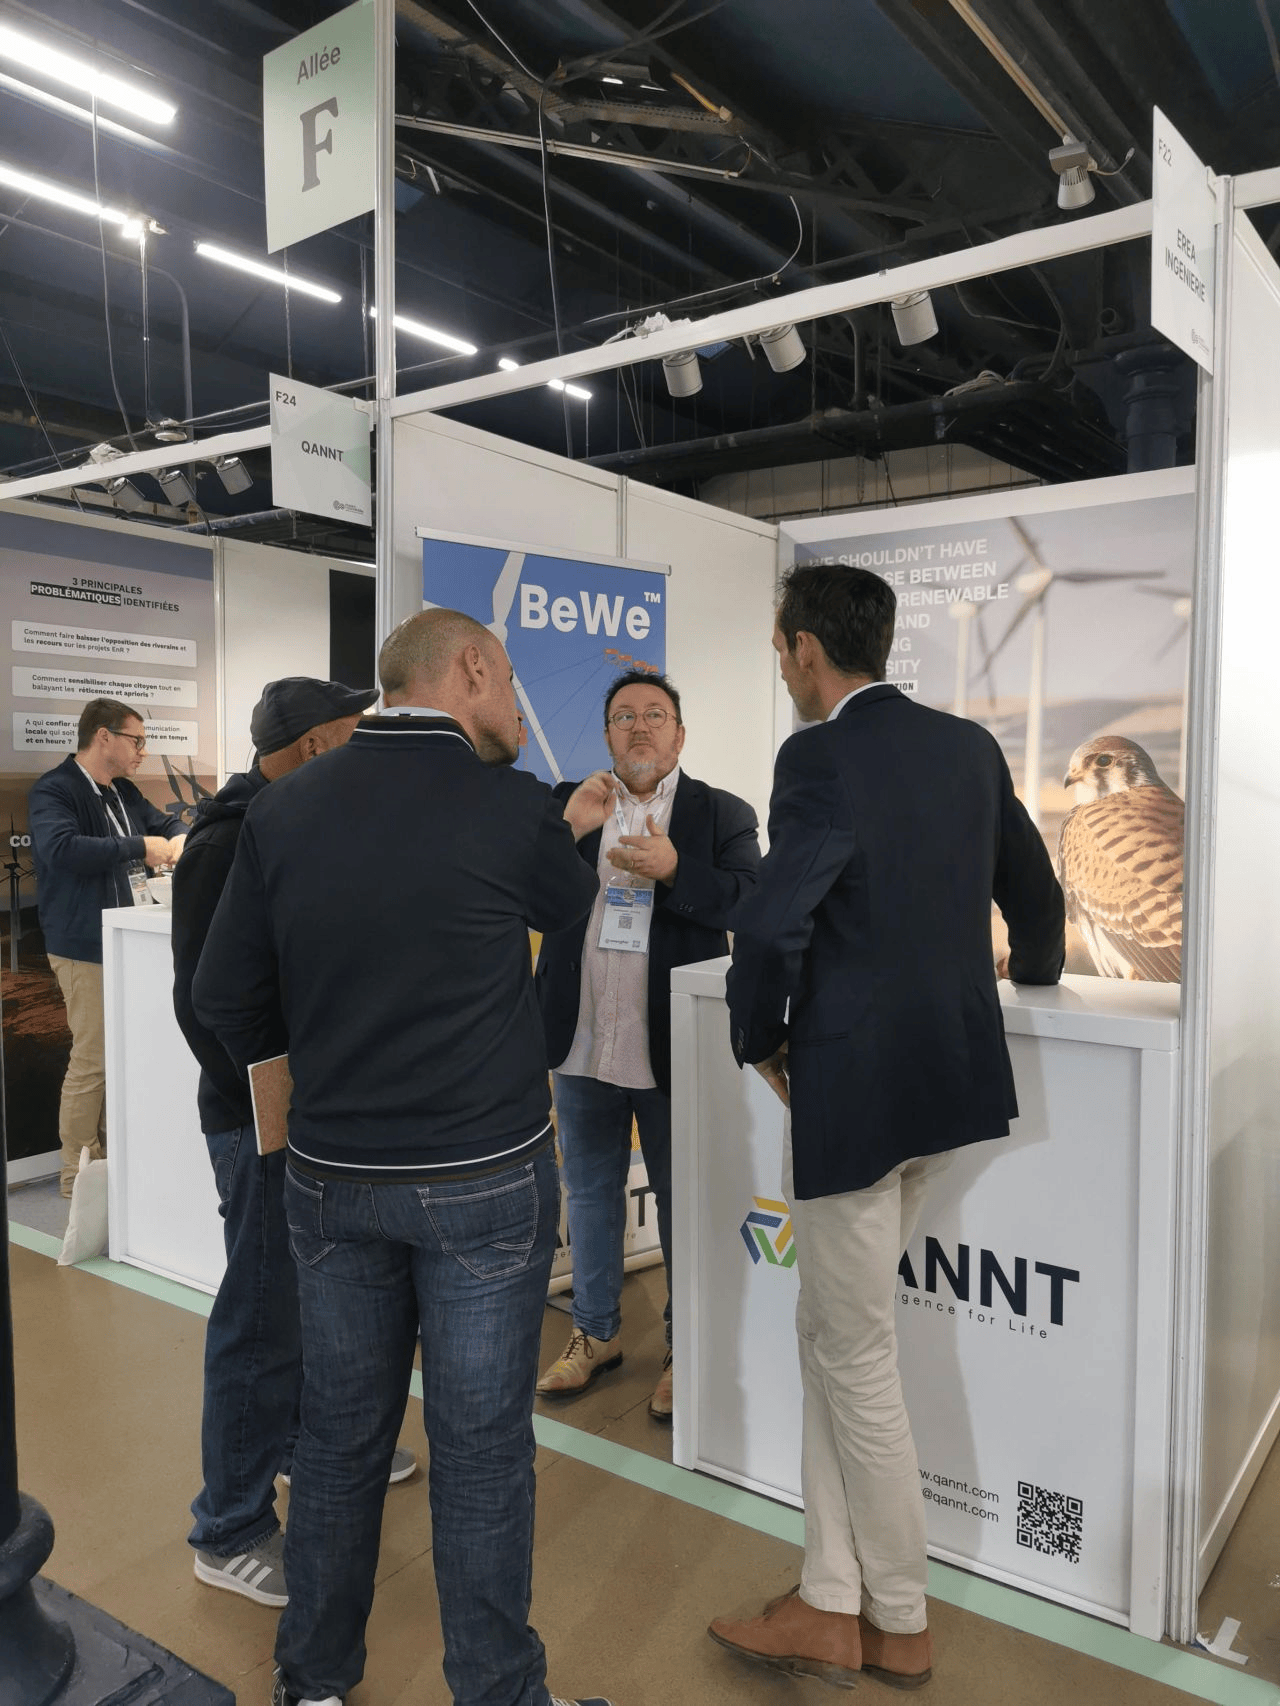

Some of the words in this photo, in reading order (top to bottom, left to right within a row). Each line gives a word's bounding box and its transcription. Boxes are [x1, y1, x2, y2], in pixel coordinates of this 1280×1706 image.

[297, 45, 341, 85] Allée
[299, 96, 339, 193] F
[1158, 138, 1173, 167] F22
[1177, 227, 1196, 265] EREA
[1165, 246, 1206, 303] INGENIERIE
[275, 390, 297, 407] F24
[301, 440, 344, 463] QANNT
[838, 544, 935, 568] SHOULDN'T
[940, 538, 988, 559] HAVE
[881, 570, 905, 587] SE
[909, 561, 997, 585] BETWEEN
[72, 577, 78, 586] 3
[81, 578, 143, 595] PRINCIPALES
[31, 584, 121, 604] PROBLÉMATIQUES
[123, 597, 180, 612] IDENTIFIÉES
[24, 628, 58, 638] Comment
[59, 631, 75, 639] faire
[76, 633, 100, 642] baisser
[101, 636, 139, 647] l'opposition
[152, 642, 179, 651] riverains
[36, 639, 63, 647] recours
[87, 643, 111, 653] projets
[891, 637, 912, 653] NG
[885, 658, 921, 676] SITY
[32, 674, 67, 683] Comment
[68, 678, 108, 686] sensibiliser
[108, 680, 133, 689] chaque
[133, 682, 158, 691] citoyen
[32, 683, 63, 692] balayant
[64, 685, 75, 693] les
[78, 687, 114, 695] réticences
[123, 690, 149, 698] aprioris
[894, 682, 914, 691] TION
[25, 727, 48, 735] locale
[48, 729, 60, 737] qui
[168, 734, 188, 742] temps
[45, 737, 67, 745] heure
[895, 1293, 956, 1315] gence
[968, 1308, 996, 1325] for
[1009, 1319, 1047, 1339] Life
[919, 1468, 1000, 1503] w.qannt.com
[921, 1487, 999, 1523] @qannt.com
